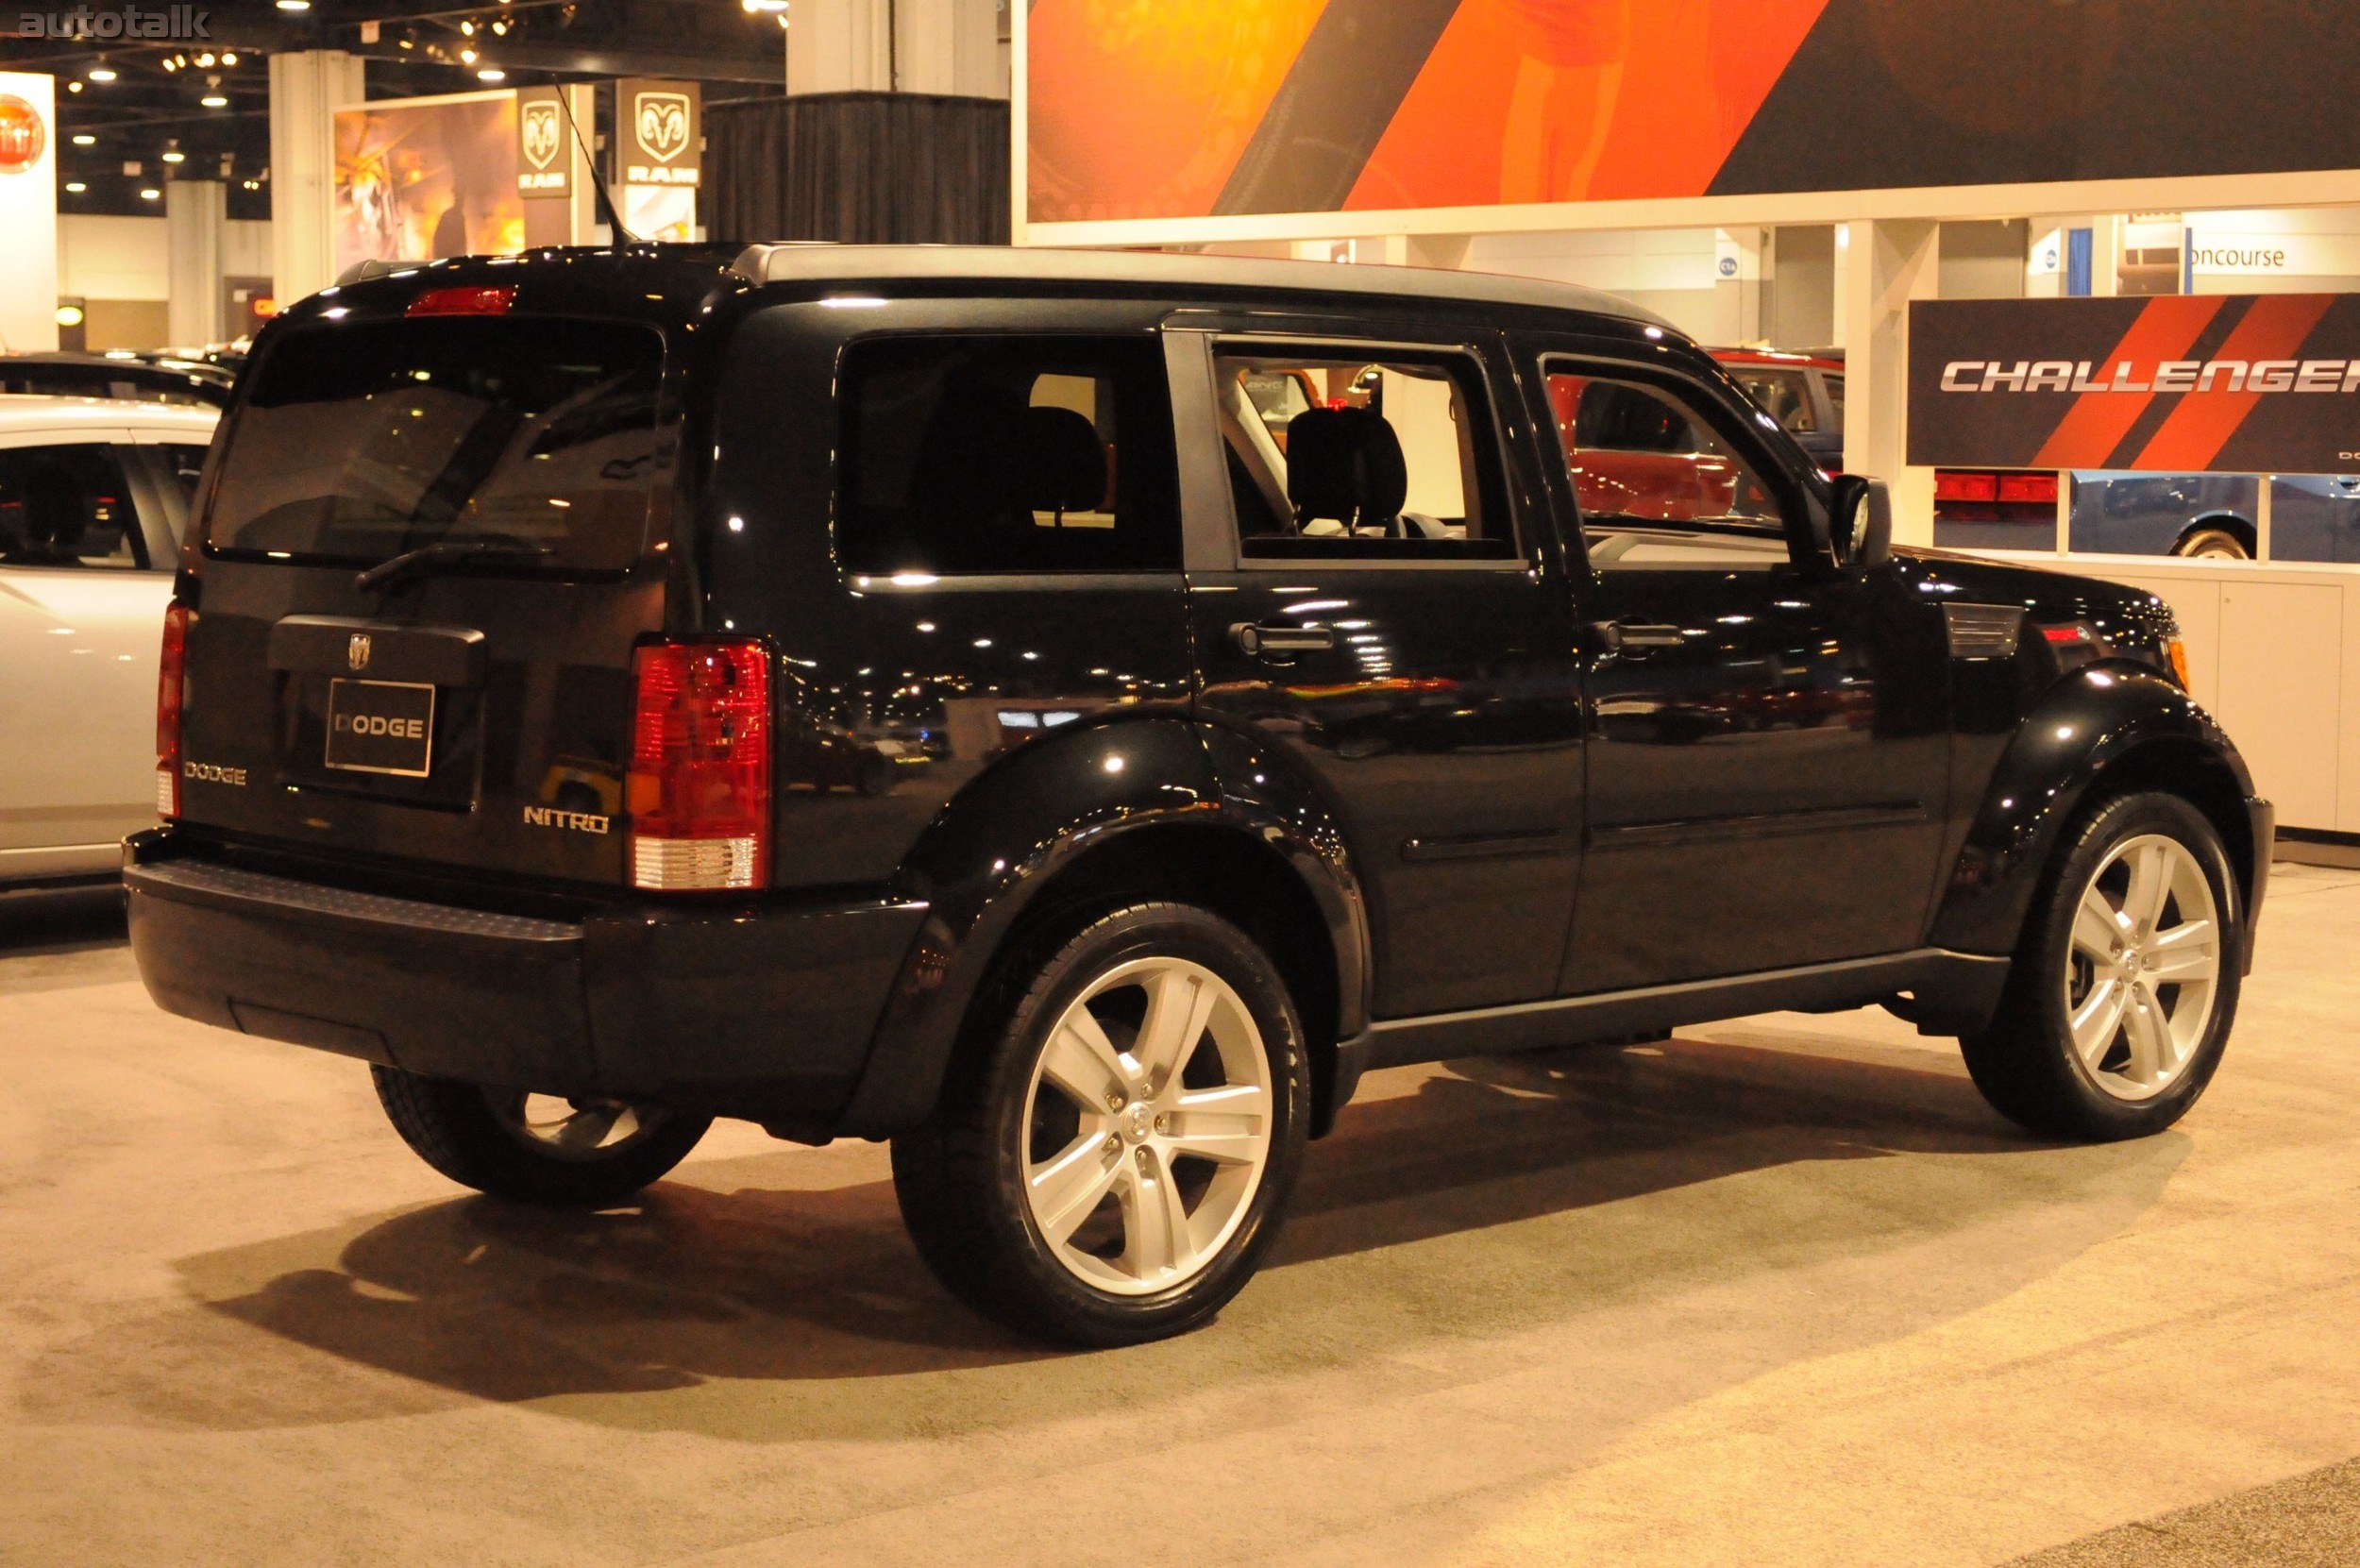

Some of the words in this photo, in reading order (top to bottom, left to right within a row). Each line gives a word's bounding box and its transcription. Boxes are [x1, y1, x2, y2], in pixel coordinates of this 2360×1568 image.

[518, 173, 565, 189] RAM
[627, 165, 700, 184] RAM
[334, 713, 423, 739] DODGE
[184, 761, 247, 786] DODGE
[523, 805, 609, 835] NITRO
